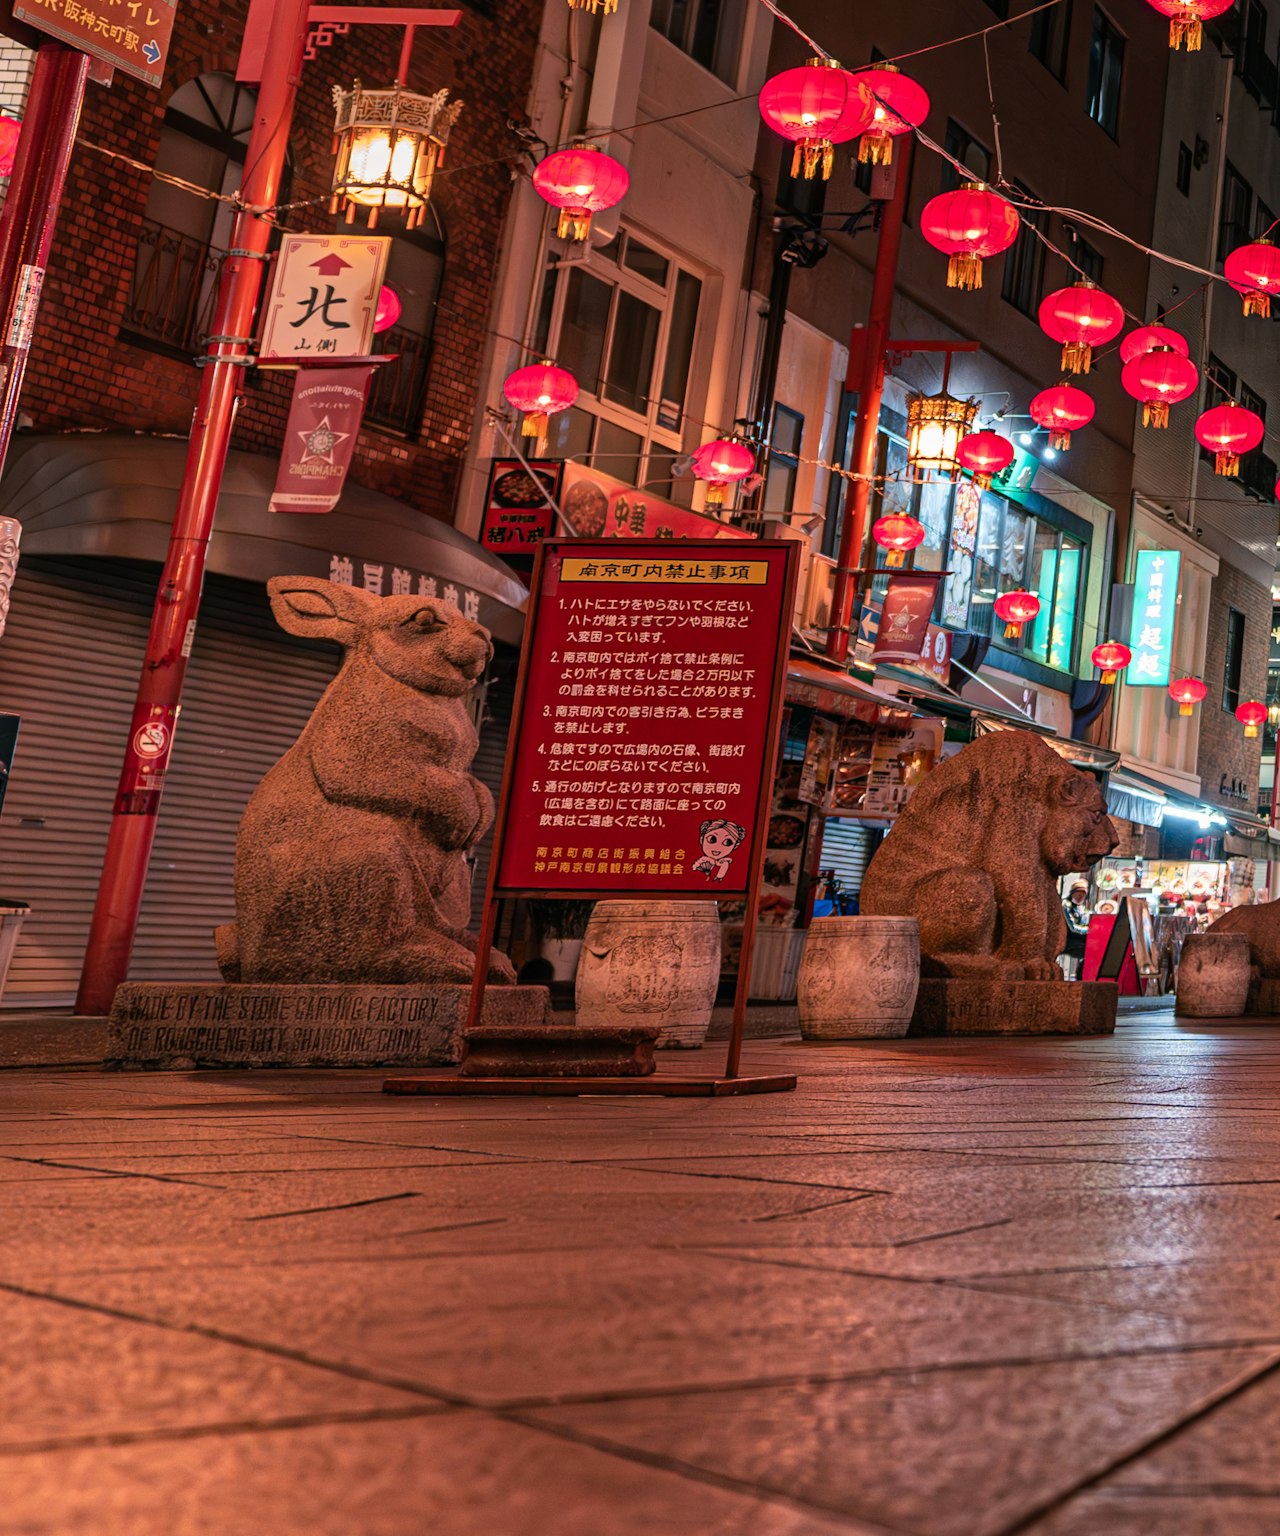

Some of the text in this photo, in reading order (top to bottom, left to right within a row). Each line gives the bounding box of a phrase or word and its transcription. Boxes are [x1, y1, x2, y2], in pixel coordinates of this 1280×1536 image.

[289, 284, 351, 331] 北
[294, 338, 337, 353] 山側
[579, 563, 751, 581] 南京町内禁止事項
[568, 614, 749, 629] ハトが増えすぎてフンや羽根など
[563, 652, 744, 665] 南京町内ではポイ捨て禁止条例に
[555, 705, 744, 719] 南京町内での客引き行為、ビラまき
[544, 781, 741, 795] 通行の妨げとなりますので南京町内
[536, 846, 687, 861] 南京町商店街振興組合
[533, 861, 685, 875] 神戸南京町景観形成協議会
[129, 993, 439, 1023] MADE BY THE STONE CARVING FACTORY
[128, 1026, 150, 1052] OF
[250, 1026, 288, 1052] CITY
[376, 1027, 425, 1053] CHINA
